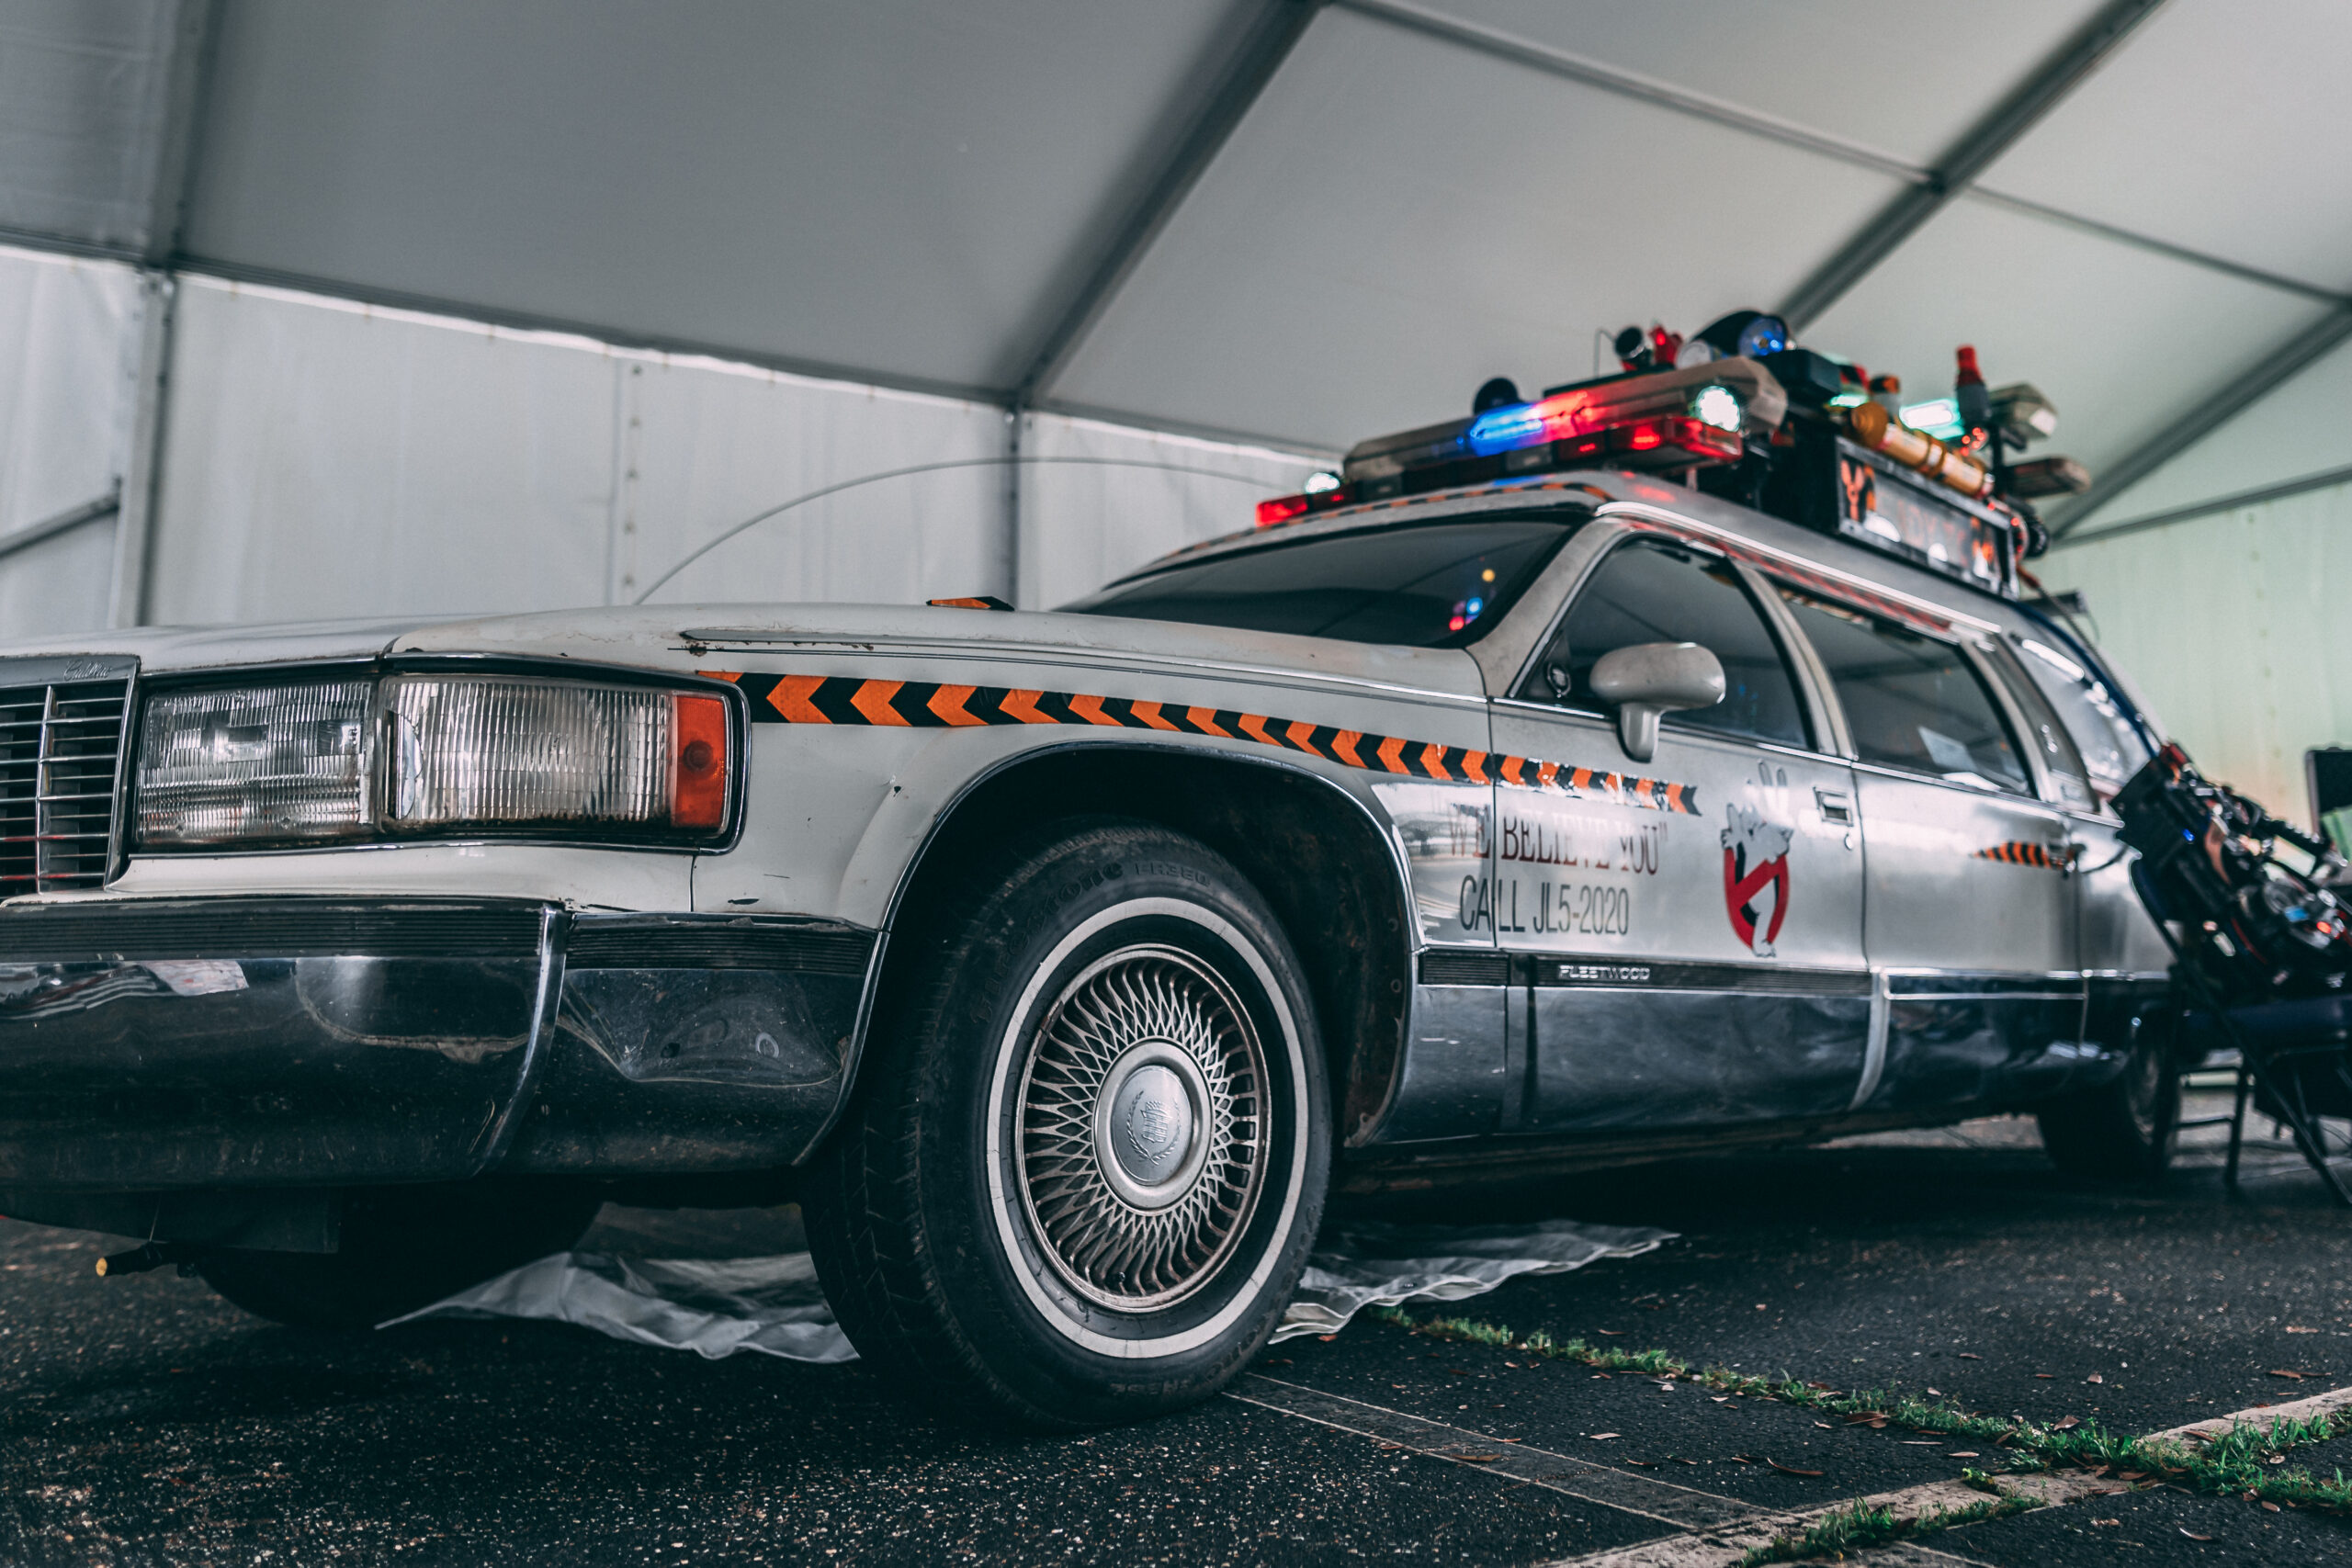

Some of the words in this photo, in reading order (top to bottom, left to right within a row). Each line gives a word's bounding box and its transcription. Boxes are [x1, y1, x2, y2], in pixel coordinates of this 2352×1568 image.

[1460, 874, 1525, 932] CALL
[1533, 882, 1629, 935] JL5-2020
[1558, 964, 1650, 980] FLEETWOOD
